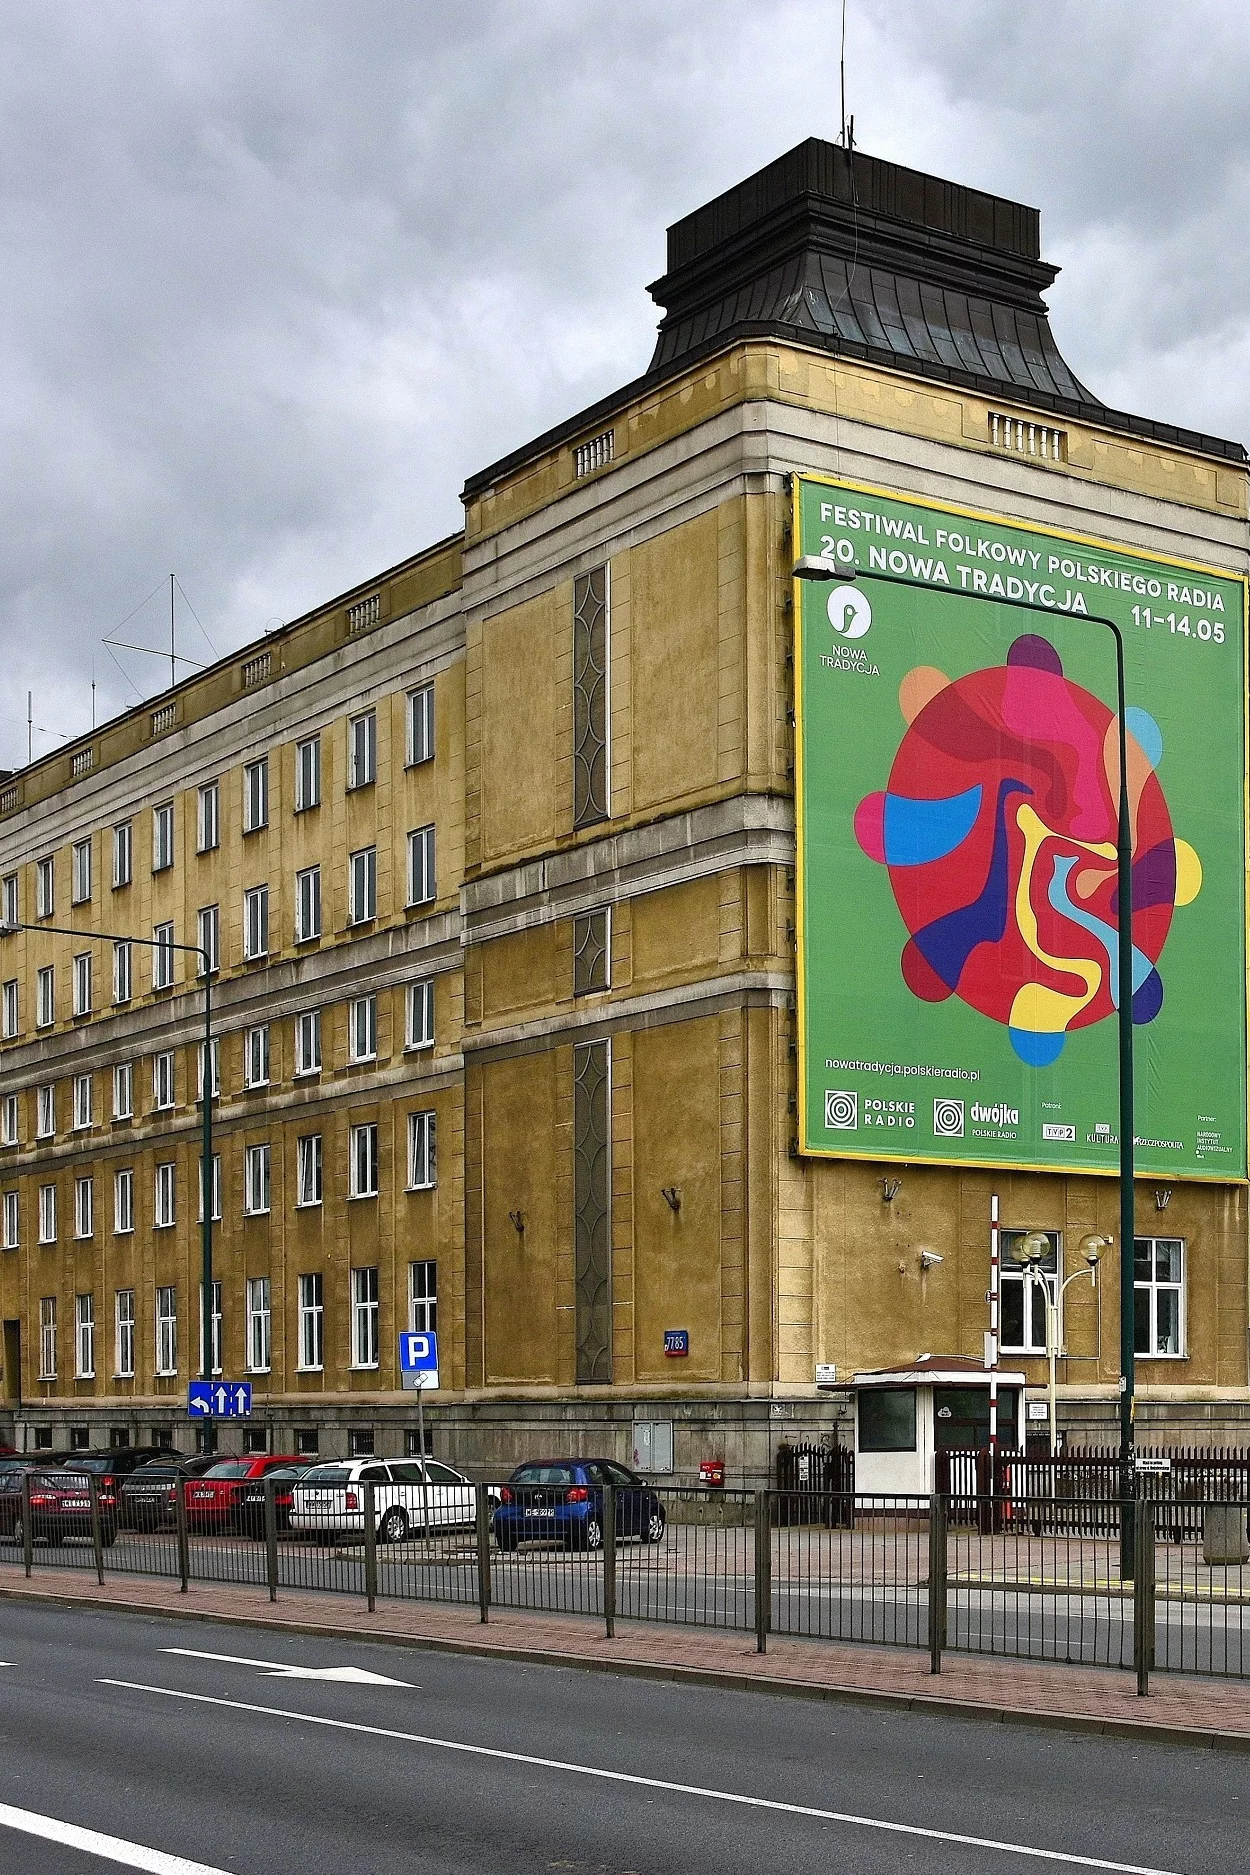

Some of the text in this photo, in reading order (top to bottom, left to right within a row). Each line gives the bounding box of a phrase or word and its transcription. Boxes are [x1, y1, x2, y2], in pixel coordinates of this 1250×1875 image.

[820, 502, 1225, 612] FESTIWAL FOLKOWY POLSKIEGO RADIA
[820, 535, 1089, 615] 20. NOWA TRADYCJA
[832, 644, 868, 662] NOWA
[819, 654, 880, 677] TRADYCJA
[825, 1058, 980, 1083] nowatradycja.polskieradio.pl
[864, 1099, 915, 1113] POLSKIE
[970, 1102, 1019, 1128] dwójka
[864, 1114, 915, 1128] RADIO
[972, 1129, 996, 1138] POLSKIE
[997, 1131, 1017, 1139] RADIO
[1086, 1133, 1119, 1145] KULTURA
[408, 1336, 429, 1367] P
